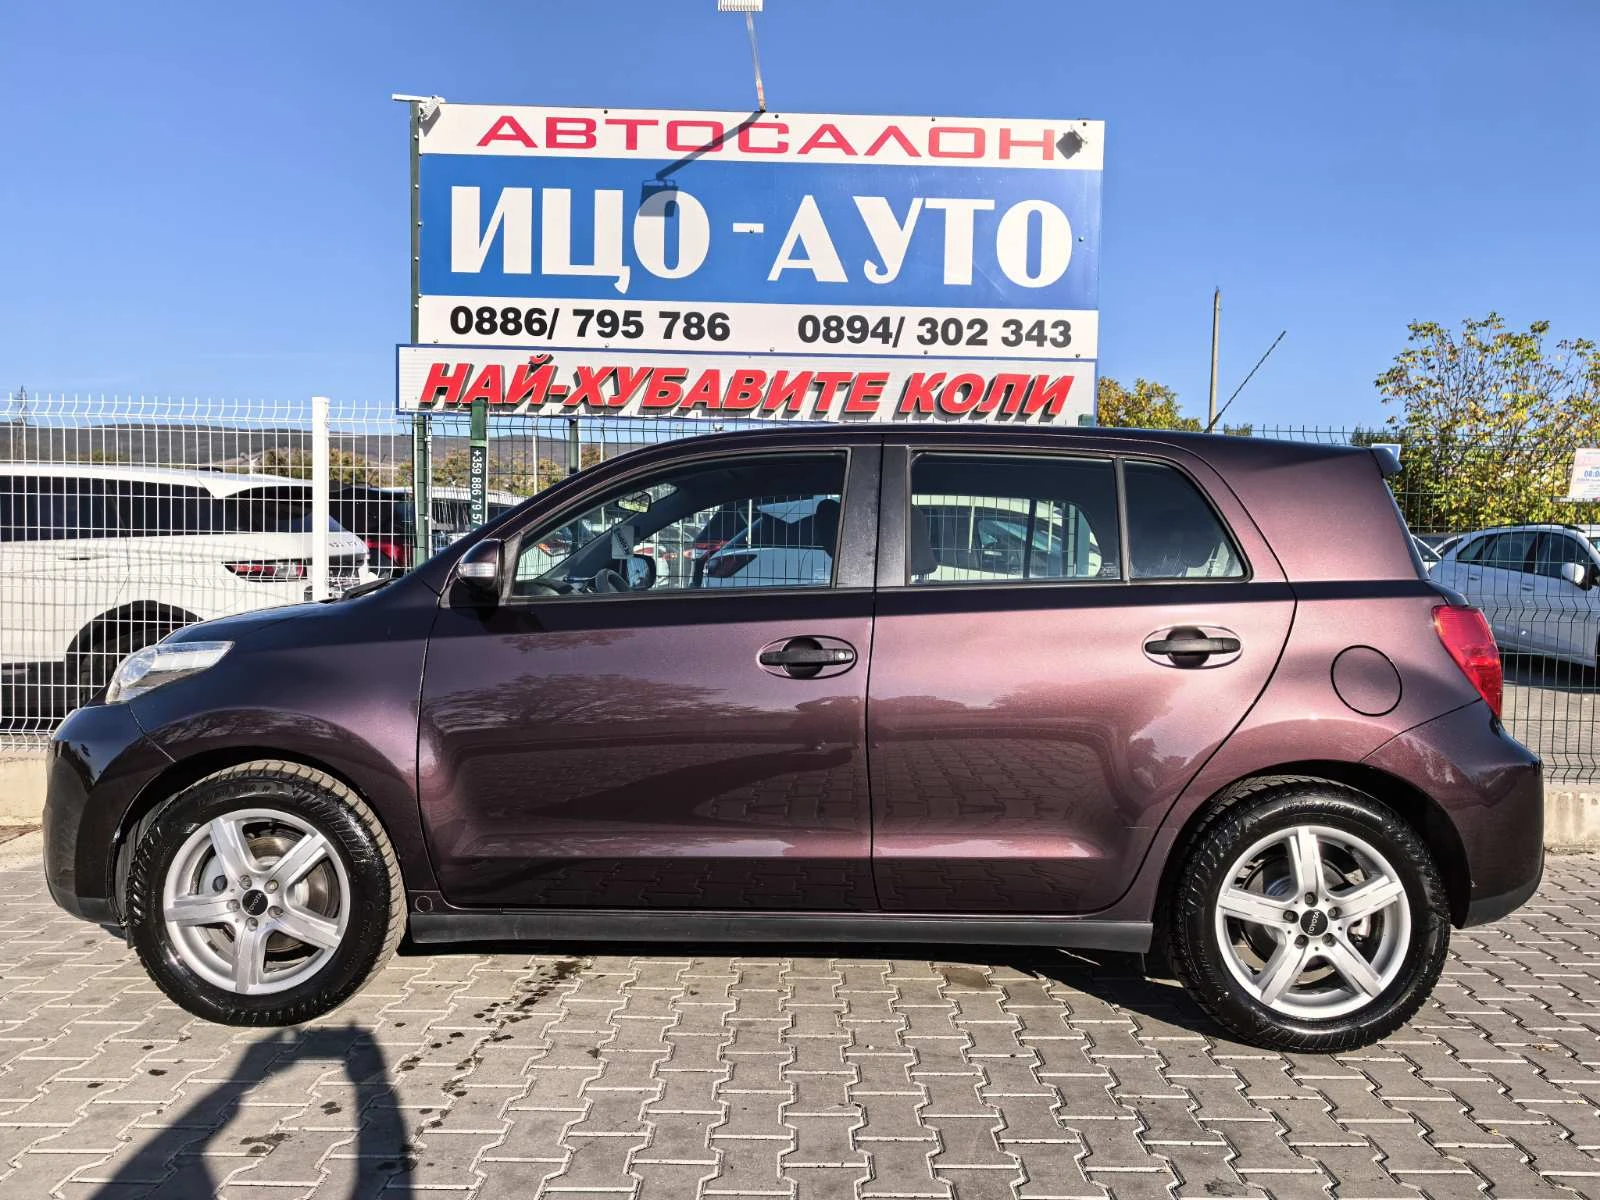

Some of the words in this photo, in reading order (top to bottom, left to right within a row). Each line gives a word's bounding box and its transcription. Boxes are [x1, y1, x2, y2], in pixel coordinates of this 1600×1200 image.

[477, 115, 1055, 160] АВТОСАЛОН
[449, 305, 560, 340] 0886/
[572, 308, 644, 339] 795
[659, 311, 731, 342] 786
[797, 314, 906, 348] 0894/
[916, 317, 988, 346] 302
[1001, 319, 1072, 348] 343
[419, 353, 890, 414] НАЙ-ХУБАВИТЕ
[900, 371, 1075, 417] КОЛИ
[472, 449, 483, 474] +359
[471, 478, 482, 495] 886
[471, 498, 482, 511] 79
[246, 892, 263, 914] TOYOTA
